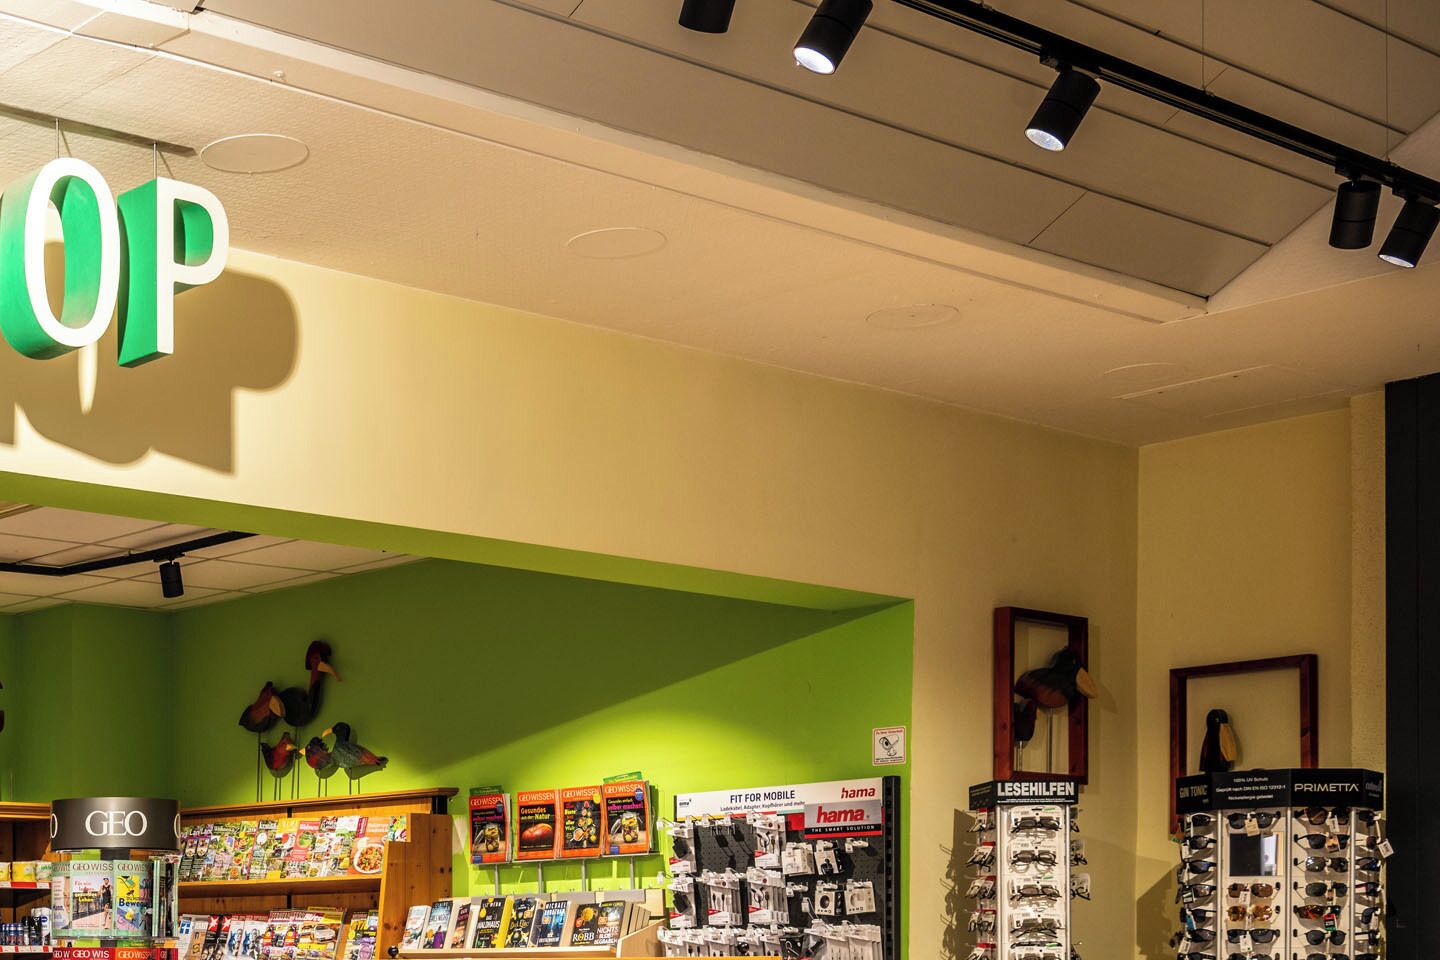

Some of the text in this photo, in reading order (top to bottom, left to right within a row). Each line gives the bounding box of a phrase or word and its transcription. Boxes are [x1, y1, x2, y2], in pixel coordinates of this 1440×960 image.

[840, 786, 876, 800] hama
[997, 782, 1075, 797] LESEHILFEN
[1179, 785, 1209, 798] GIN TONIC
[1294, 783, 1360, 793] PRIMETTA
[729, 790, 796, 805] FIT FOR MOBILE
[520, 806, 547, 815] Gesundes
[816, 805, 865, 824] hama
[535, 813, 551, 821] Natur
[85, 810, 148, 838] GEO
[72, 863, 90, 872] GEO
[72, 950, 91, 958] GEO
[118, 950, 135, 959] GEO
